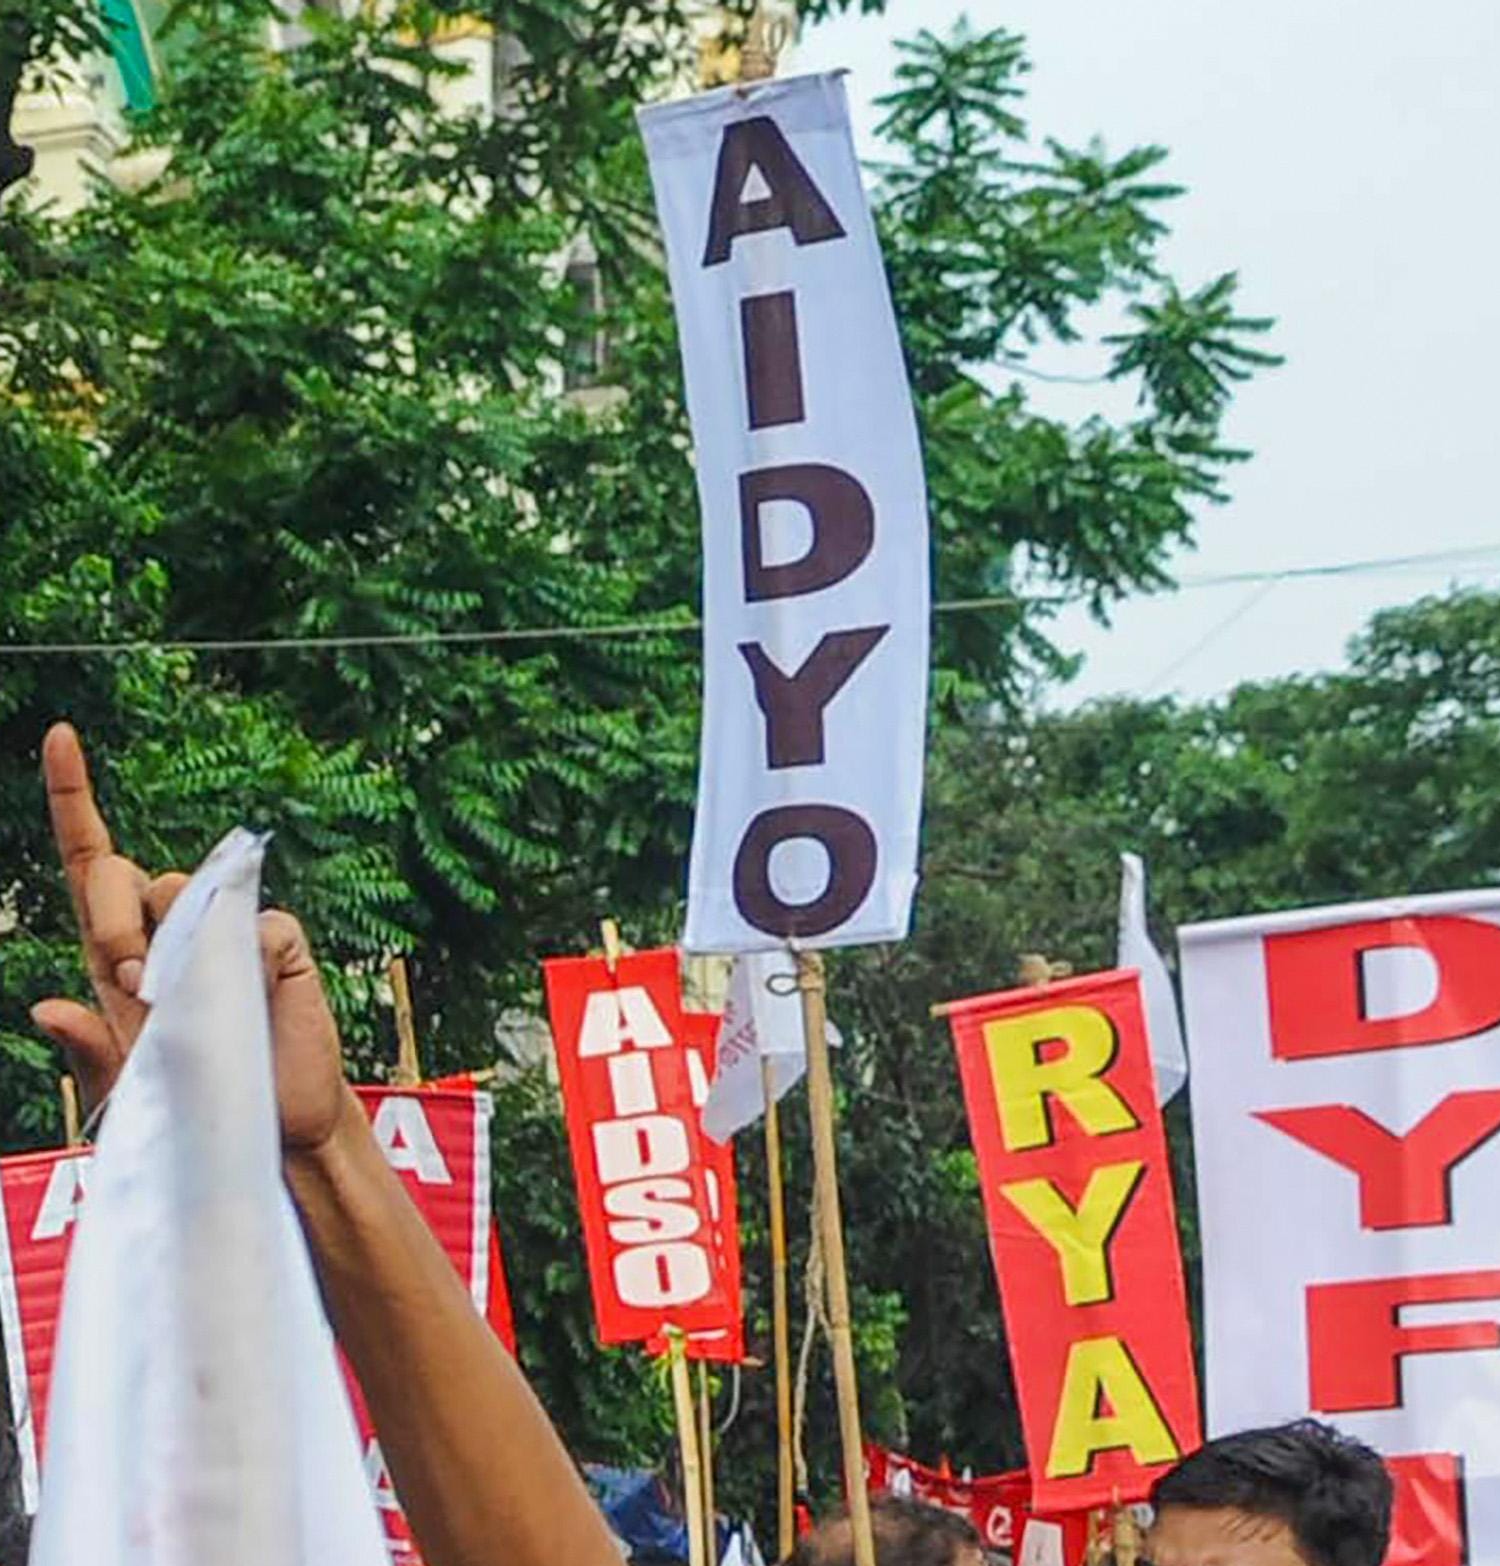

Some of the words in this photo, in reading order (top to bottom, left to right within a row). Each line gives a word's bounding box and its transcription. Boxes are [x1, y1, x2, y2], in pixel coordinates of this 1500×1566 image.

[701, 115, 890, 940] AIDYO
[577, 985, 712, 1309] AIDSO
[981, 1004, 1181, 1481] RYA
